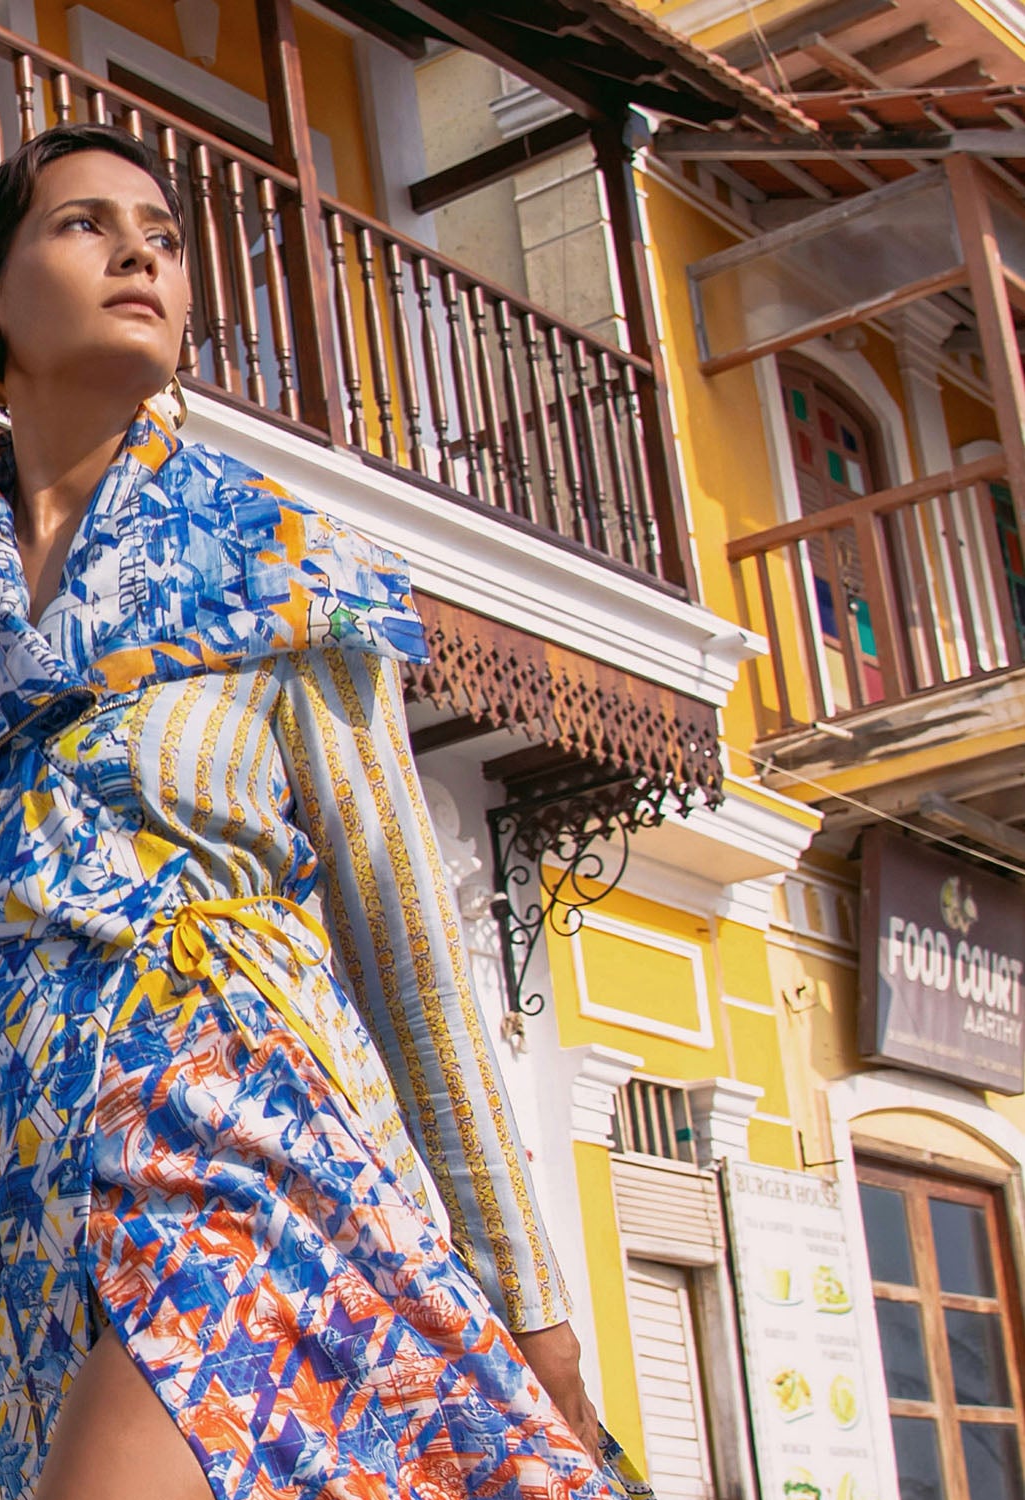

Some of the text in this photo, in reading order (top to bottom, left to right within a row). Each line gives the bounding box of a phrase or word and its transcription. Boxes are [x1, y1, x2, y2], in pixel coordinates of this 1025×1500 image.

[888, 916, 1023, 1015] FOOD COURT
[735, 1172, 792, 1200] BURGER
